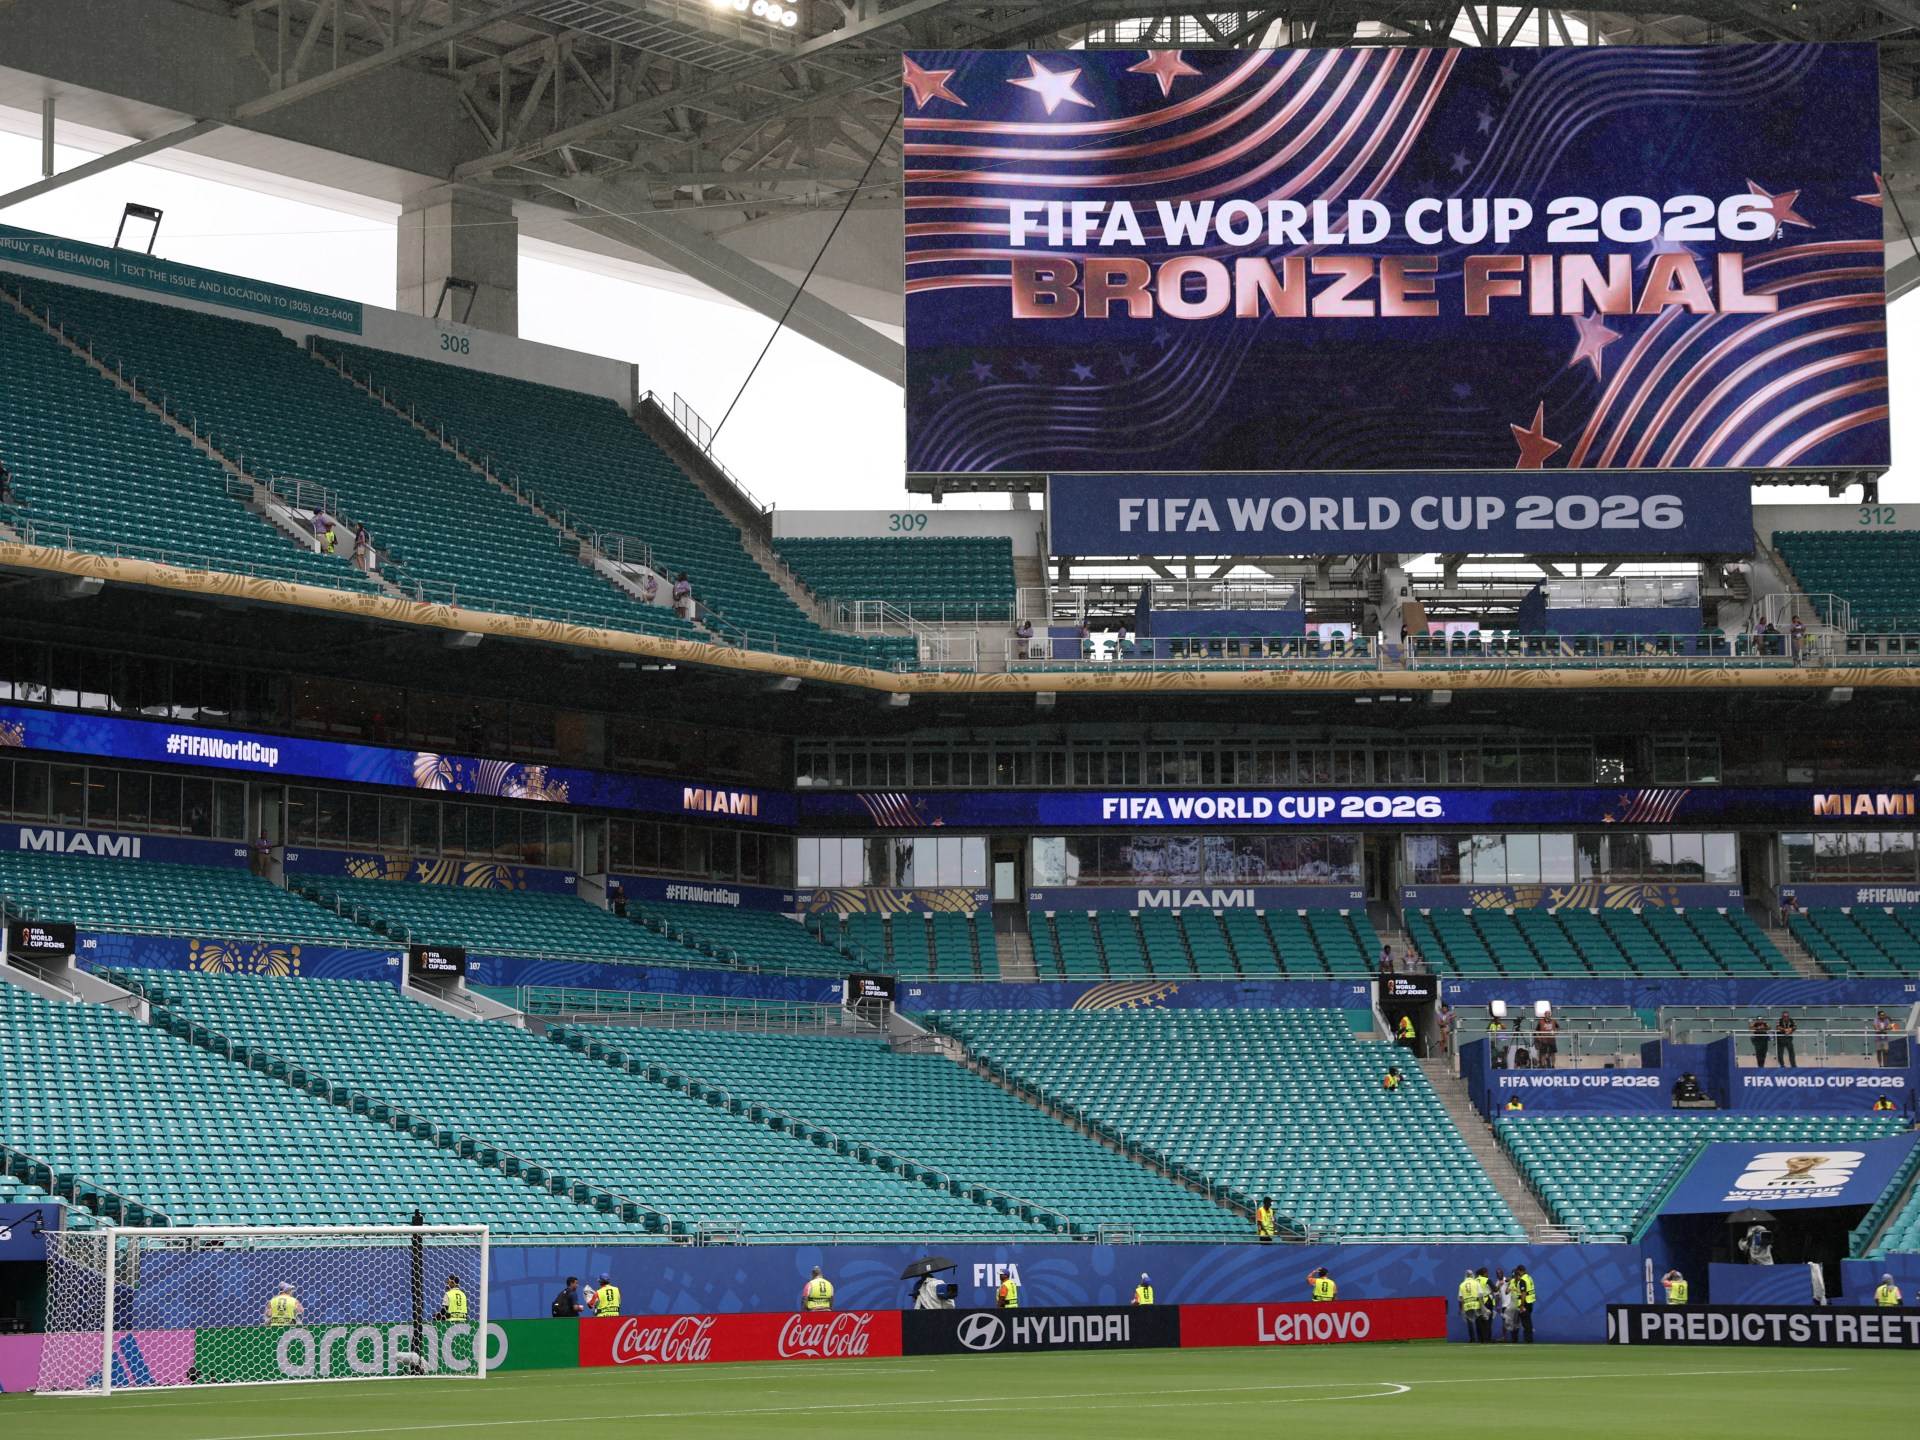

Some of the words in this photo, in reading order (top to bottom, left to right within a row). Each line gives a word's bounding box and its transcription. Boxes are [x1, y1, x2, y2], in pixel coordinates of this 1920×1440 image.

[1009, 199, 1146, 246] FIFA
[1155, 199, 1391, 247] WORLD
[1404, 197, 1533, 245] CUP
[1546, 194, 1776, 243] 2026
[33, 244, 55, 258] FAN
[57, 250, 110, 270] BEHAVIOR
[121, 263, 146, 277] TEXT
[147, 269, 167, 282] THE
[169, 274, 196, 288] ISSUE
[198, 280, 221, 293] AND
[223, 286, 271, 304] LOCATION
[273, 296, 287, 307] TO
[289, 299, 311, 313] (305)
[313, 306, 353, 322] 623-6400
[1011, 254, 1439, 320] BRONZE
[1463, 252, 1779, 317] FINAL
[440, 333, 470, 355] 308
[889, 513, 928, 531] 309
[1118, 498, 1219, 532] FIFA
[1227, 497, 1400, 532] WORLD
[1410, 495, 1505, 531] CUP
[1515, 494, 1684, 530] 2026
[1859, 506, 1896, 525] 312
[166, 733, 279, 768] #FIFAWorldCup
[683, 787, 758, 817] MIAMI
[1102, 797, 1164, 819] FIFA
[1168, 797, 1273, 819] WORLD
[1278, 796, 1336, 819] CUP
[1340, 795, 1442, 818] 2026
[1813, 793, 1914, 816] MIAMI
[19, 828, 141, 858] MIAMI
[234, 848, 248, 857] 206
[286, 853, 299, 861] 207
[666, 884, 740, 908] #FIFAWorldCup
[1137, 889, 1255, 907] MIAMI
[1405, 890, 1417, 898] 211
[30, 934, 53, 942] WORLD
[43, 941, 65, 949] 2026
[82, 939, 97, 948] 106
[386, 957, 400, 966] 106
[439, 963, 457, 971] 2026
[469, 961, 481, 970] 107
[1449, 985, 1461, 993] 111
[1904, 984, 1916, 992] 111
[1499, 1076, 1529, 1087] FIFA
[1530, 1076, 1580, 1087] WORLD
[1582, 1076, 1609, 1087] CUP
[1611, 1075, 1660, 1087] 2026
[1743, 1076, 1773, 1087] FIFA
[1775, 1076, 1825, 1087] WORLD
[1826, 1076, 1854, 1087] CUP
[1856, 1076, 1904, 1088] 2026
[1721, 1191, 1840, 1202] 2026
[1012, 1315, 1130, 1344] HYUNDAI
[1257, 1307, 1370, 1342] Lenovo
[1641, 1312, 1920, 1343] PREDICTSTREET
[611, 1316, 718, 1364] Coca-Cola
[777, 1312, 874, 1358] Coca-Cola
[276, 1322, 509, 1377] aramco
